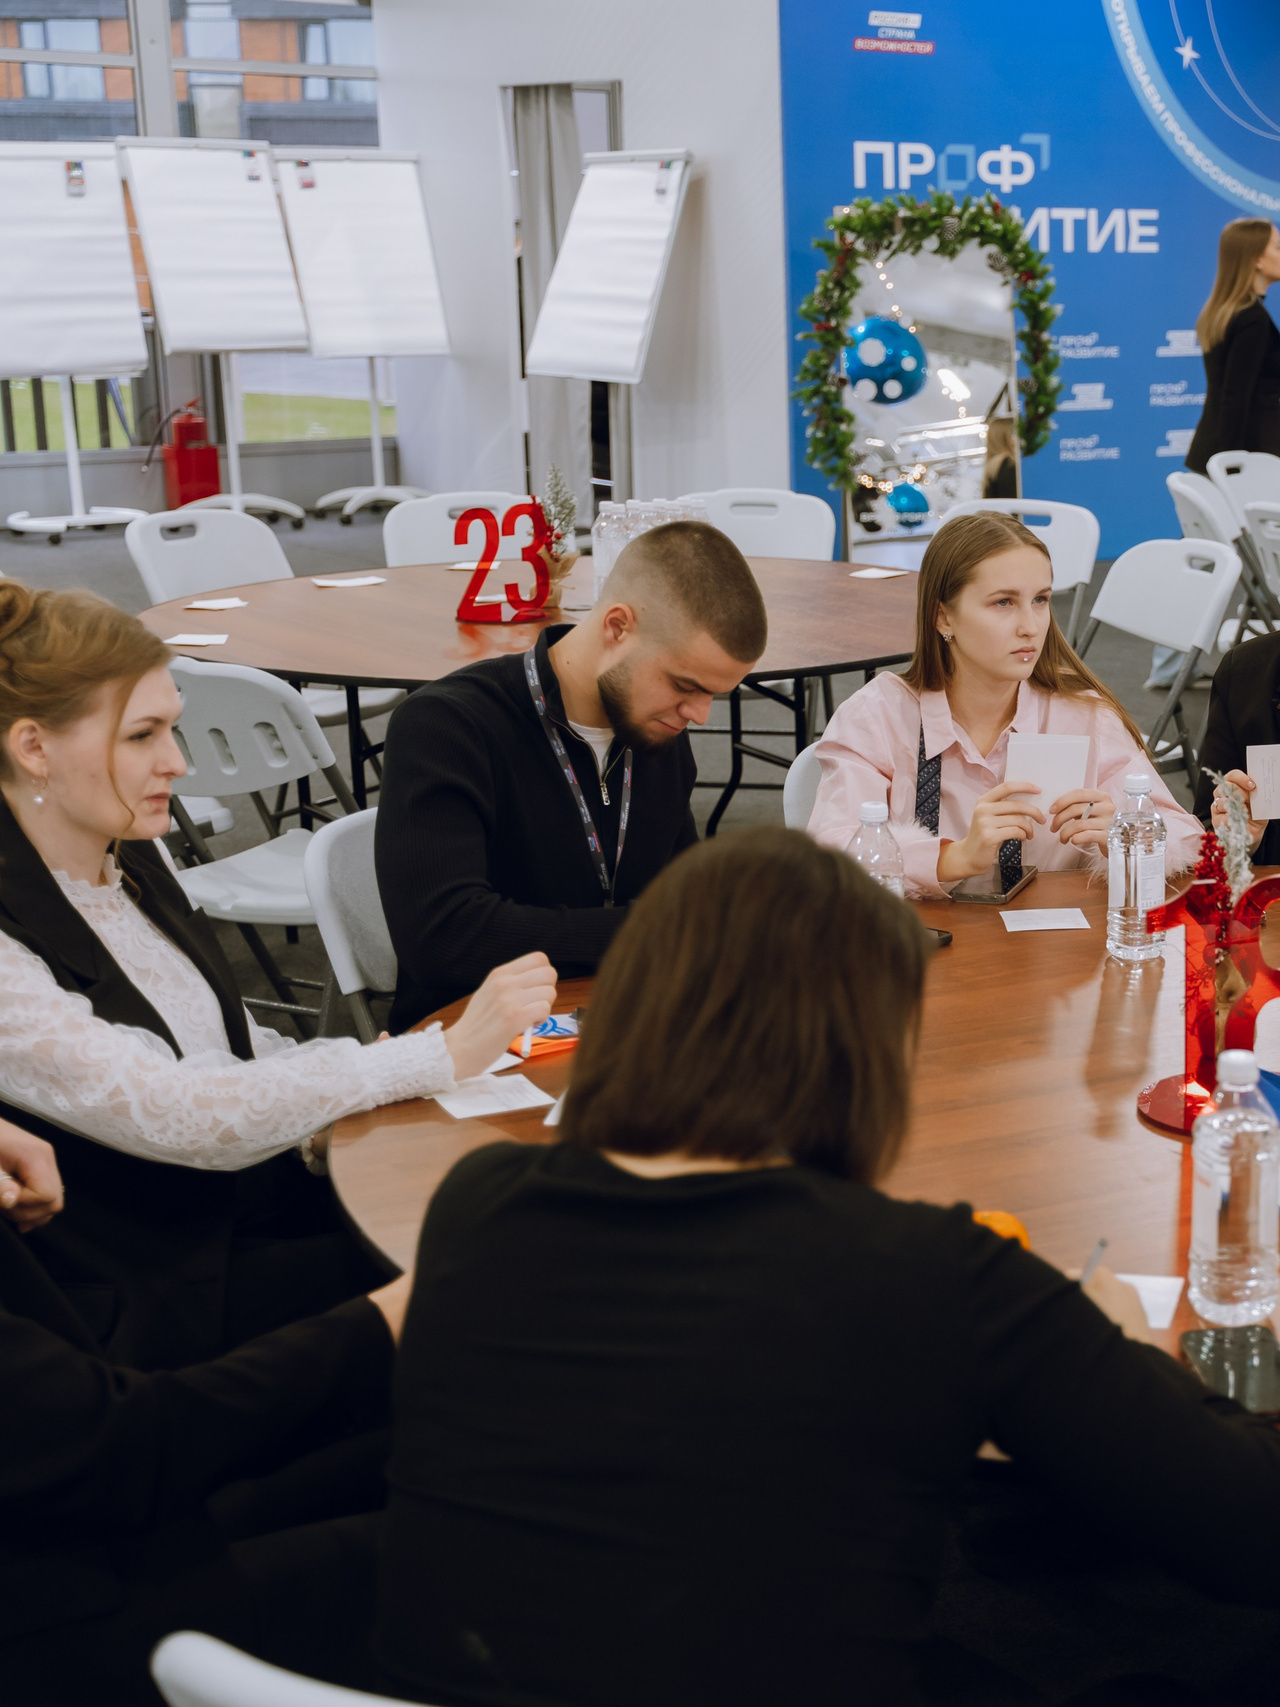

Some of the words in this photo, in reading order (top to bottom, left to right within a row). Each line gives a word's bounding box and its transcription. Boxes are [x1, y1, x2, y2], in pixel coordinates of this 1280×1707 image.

[1111, 0, 1165, 115] ОТКРЫВАЕМ
[853, 138, 1037, 194] ПРОФ
[1011, 207, 1160, 253] ИТИЕ
[454, 503, 550, 621] 23
